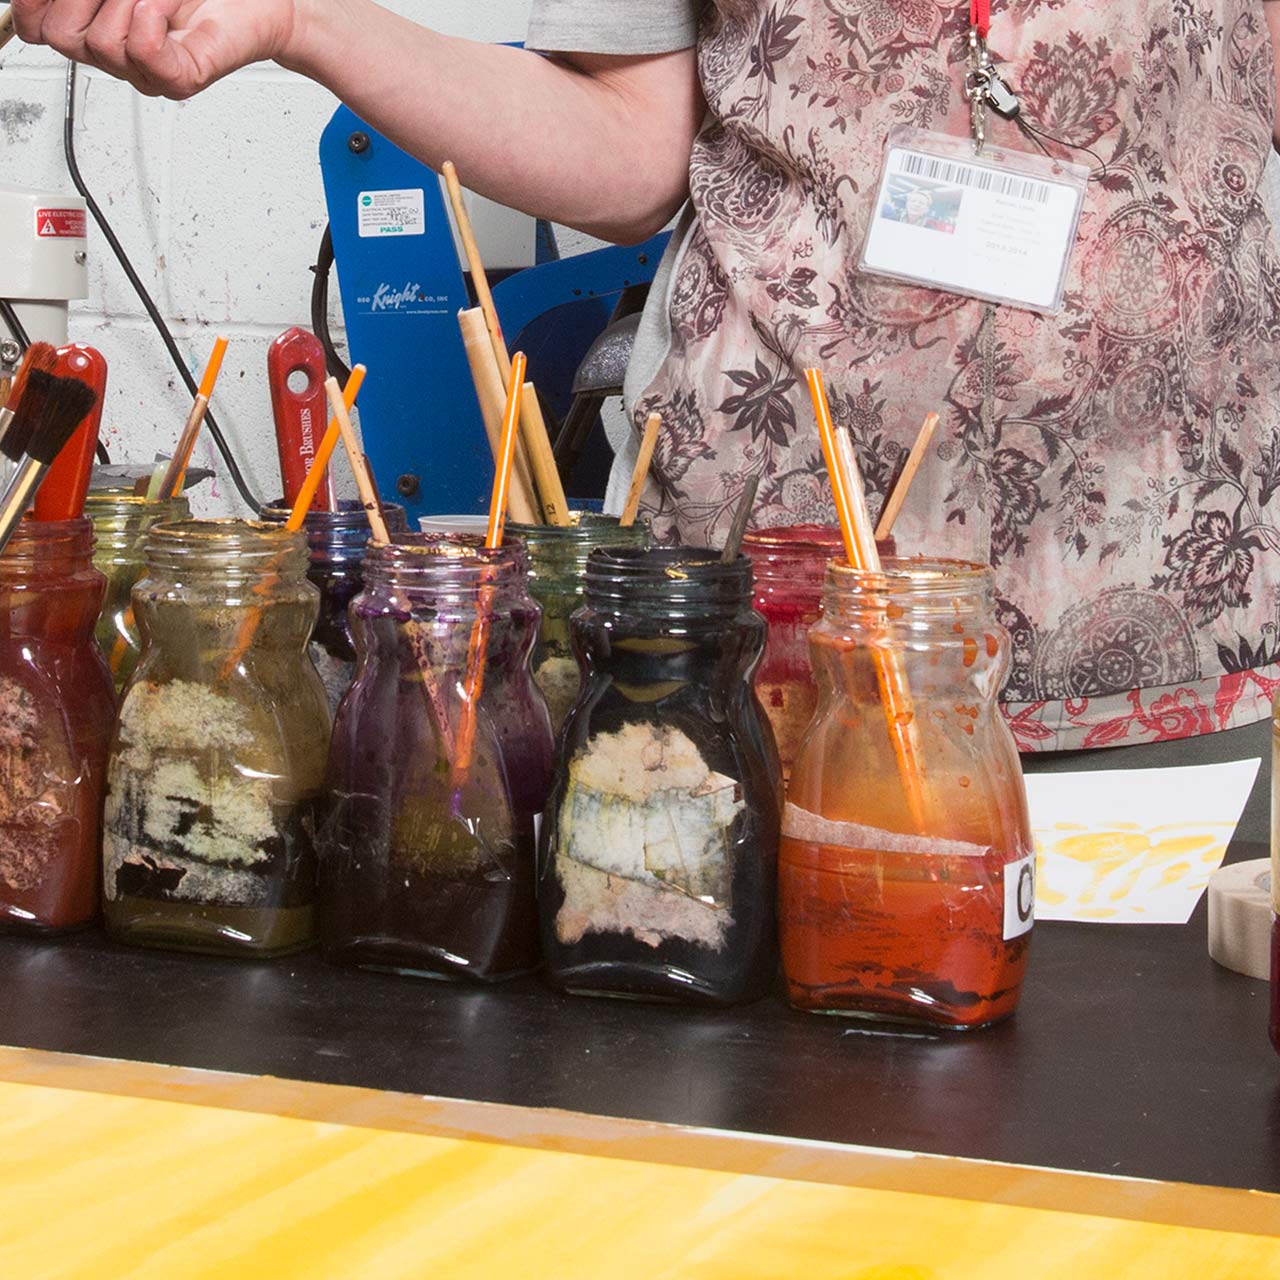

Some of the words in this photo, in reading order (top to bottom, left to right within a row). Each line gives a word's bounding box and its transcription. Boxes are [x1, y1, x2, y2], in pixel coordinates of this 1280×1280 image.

[379, 225, 404, 233] PASS
[371, 282, 420, 311] Knight
[300, 408, 314, 456] BRUSHES
[546, 503, 556, 515] 12
[1016, 858, 1037, 923] O
